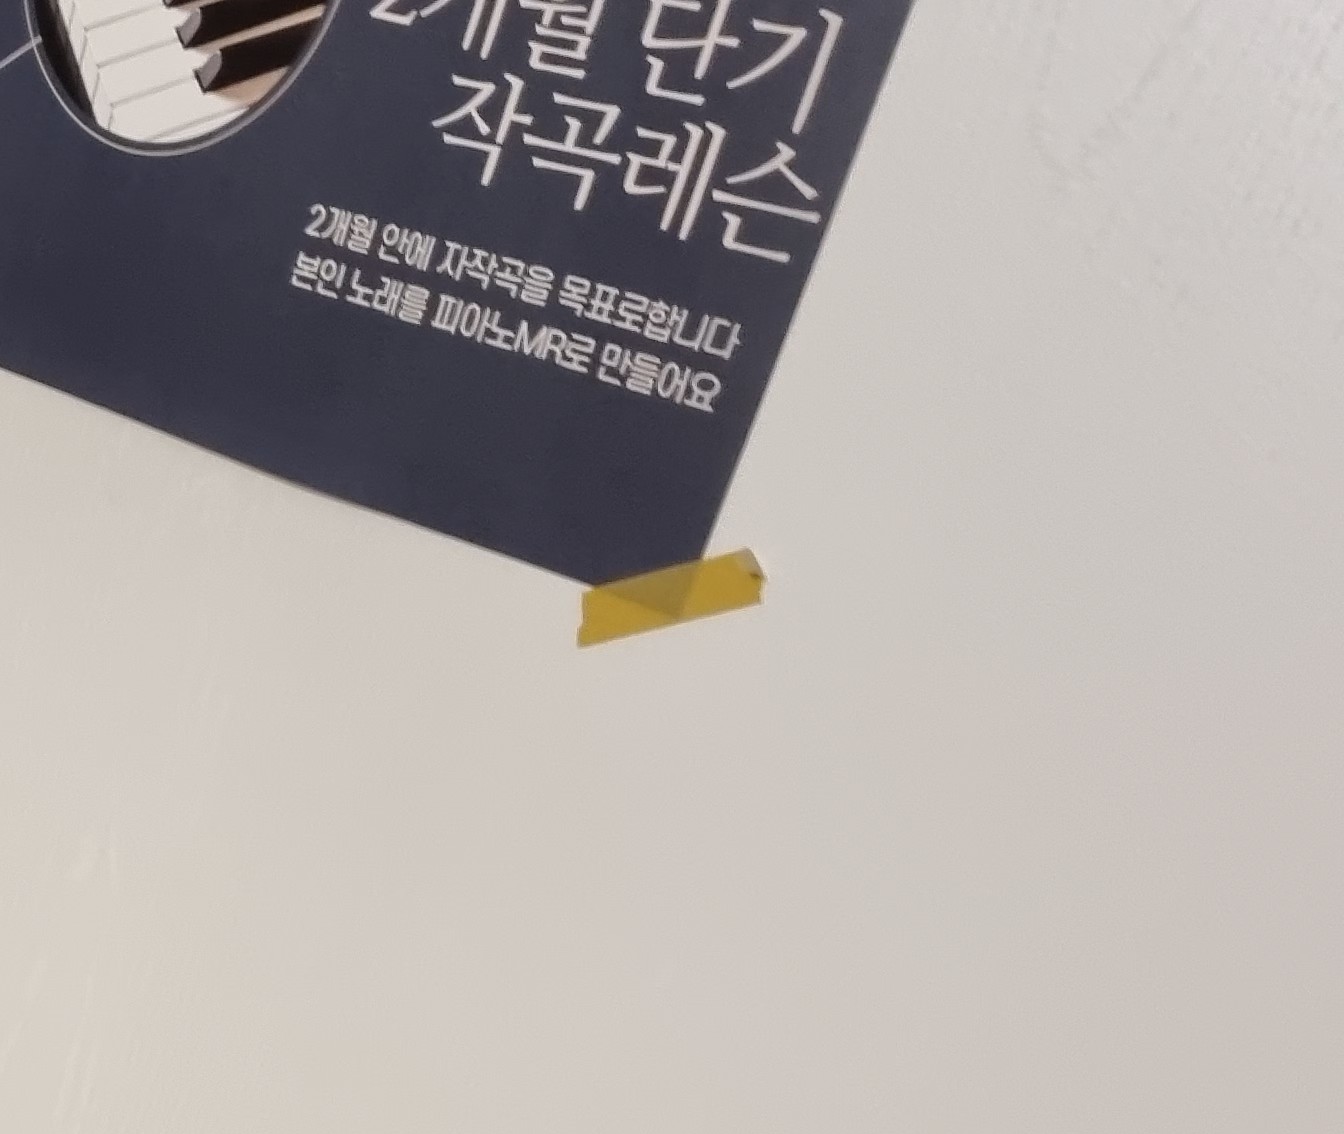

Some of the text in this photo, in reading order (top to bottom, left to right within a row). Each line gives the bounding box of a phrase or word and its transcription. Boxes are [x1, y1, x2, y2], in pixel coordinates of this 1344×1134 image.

[641, 0, 844, 135] 단기
[431, 72, 823, 264] 작곡레슨
[289, 250, 723, 414] 본인 노래를 피아노MR로 만들어요
[303, 202, 743, 361] 2개월 안에 자작곡을 목표로합니다
